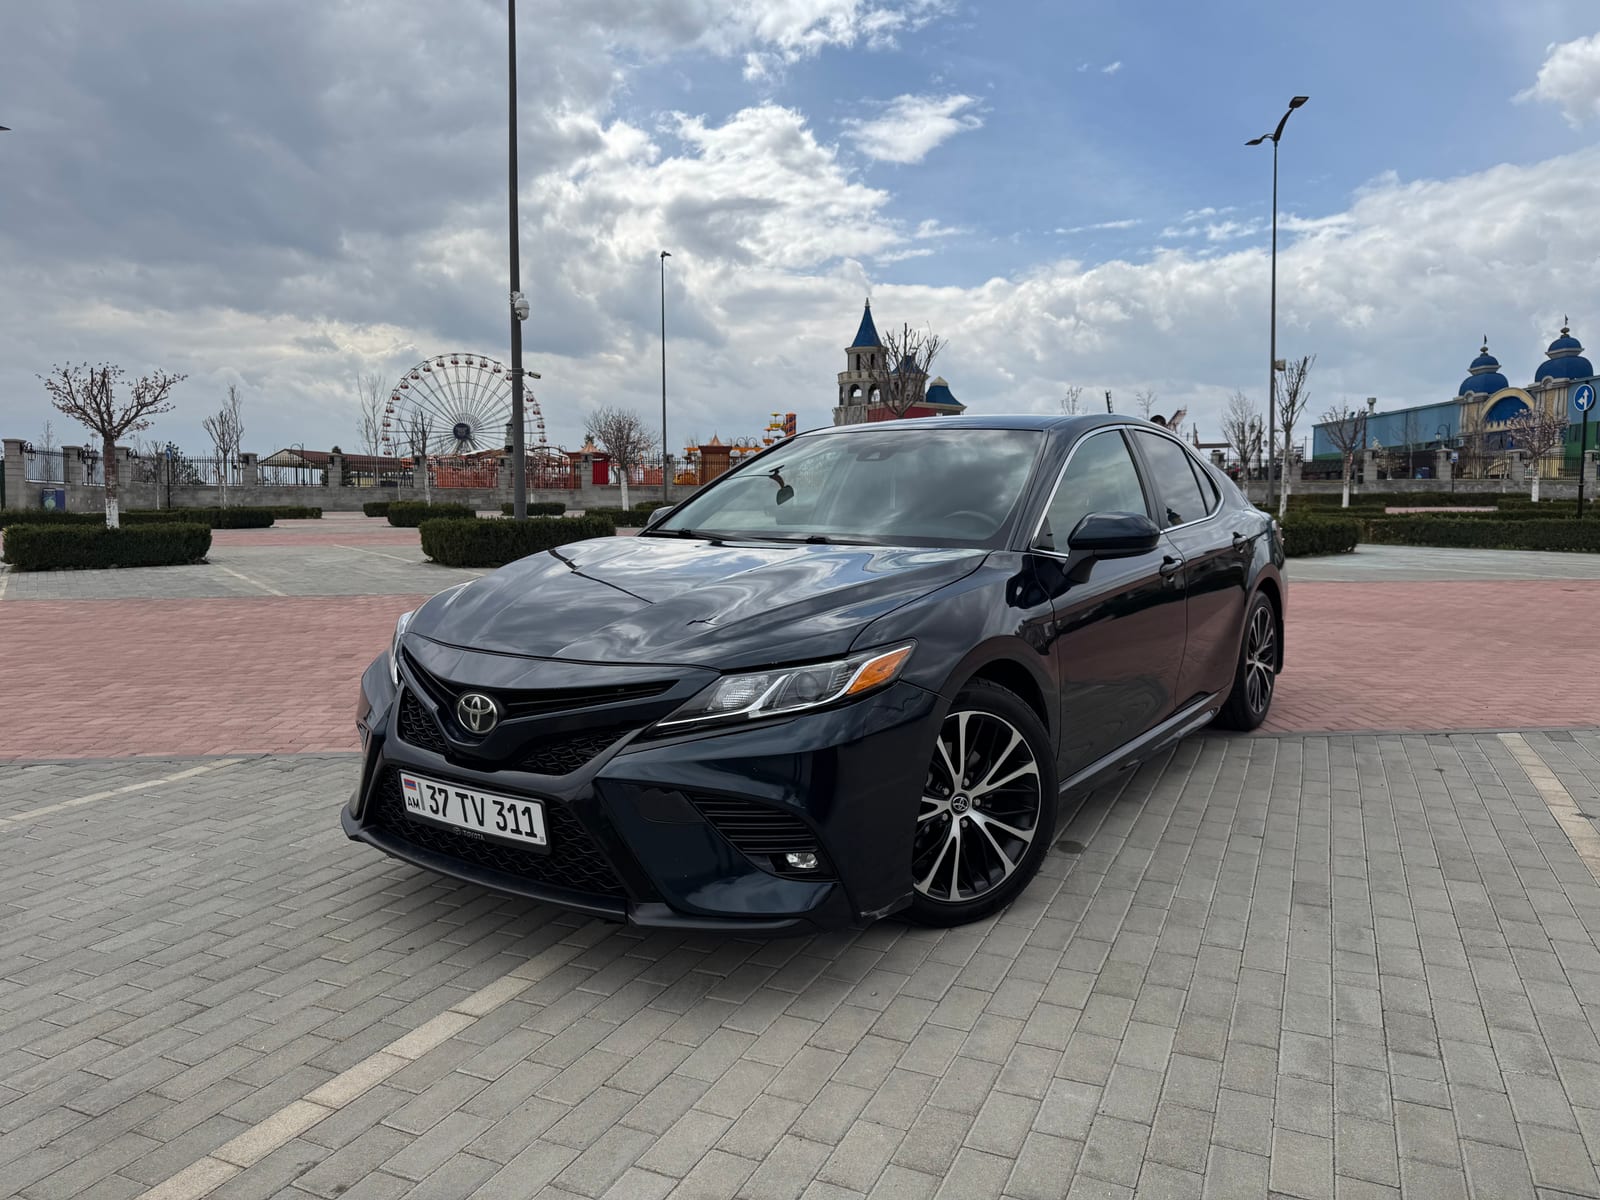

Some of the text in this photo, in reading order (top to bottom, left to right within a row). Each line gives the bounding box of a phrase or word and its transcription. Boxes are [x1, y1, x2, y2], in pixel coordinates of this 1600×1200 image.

[408, 795, 420, 810] AM
[426, 784, 538, 838] 37 TV 311
[462, 829, 486, 841] TOYOTA
